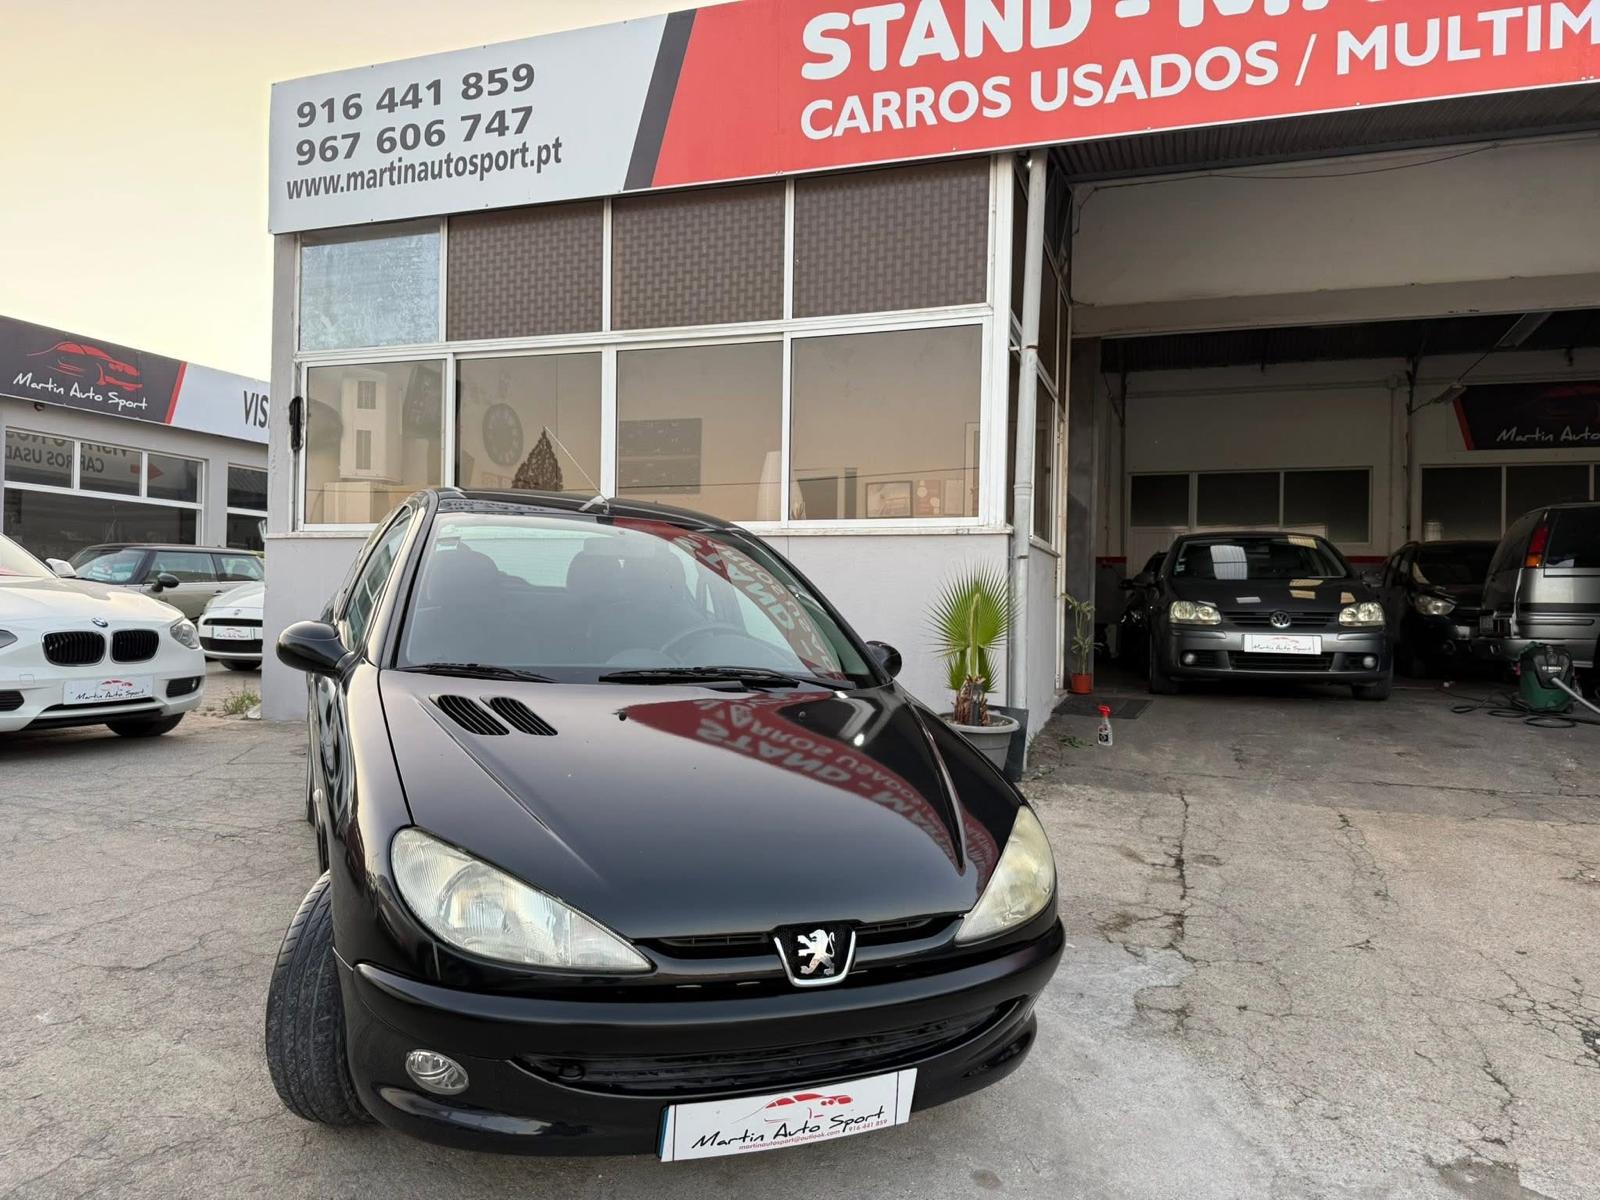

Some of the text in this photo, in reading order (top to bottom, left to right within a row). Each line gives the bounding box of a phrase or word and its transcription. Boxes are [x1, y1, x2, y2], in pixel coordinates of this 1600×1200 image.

[801, 0, 1092, 80] STAND
[296, 63, 535, 128] 916 441 859
[800, 76, 1012, 140] CARROS
[1030, 40, 1280, 112] USADOS
[1295, 33, 1317, 86] /
[1336, 1, 1600, 76] MULTIM
[296, 105, 534, 166] 967 606 747
[287, 136, 563, 200] www.martinautosport.pt
[13, 372, 148, 412] Martin Auto Sport
[243, 390, 270, 429] VIS
[1496, 426, 1554, 442] Martin
[75, 692, 103, 701] Martin
[105, 690, 123, 699] Auto
[691, 1105, 885, 1149] Martin Auto Sport
